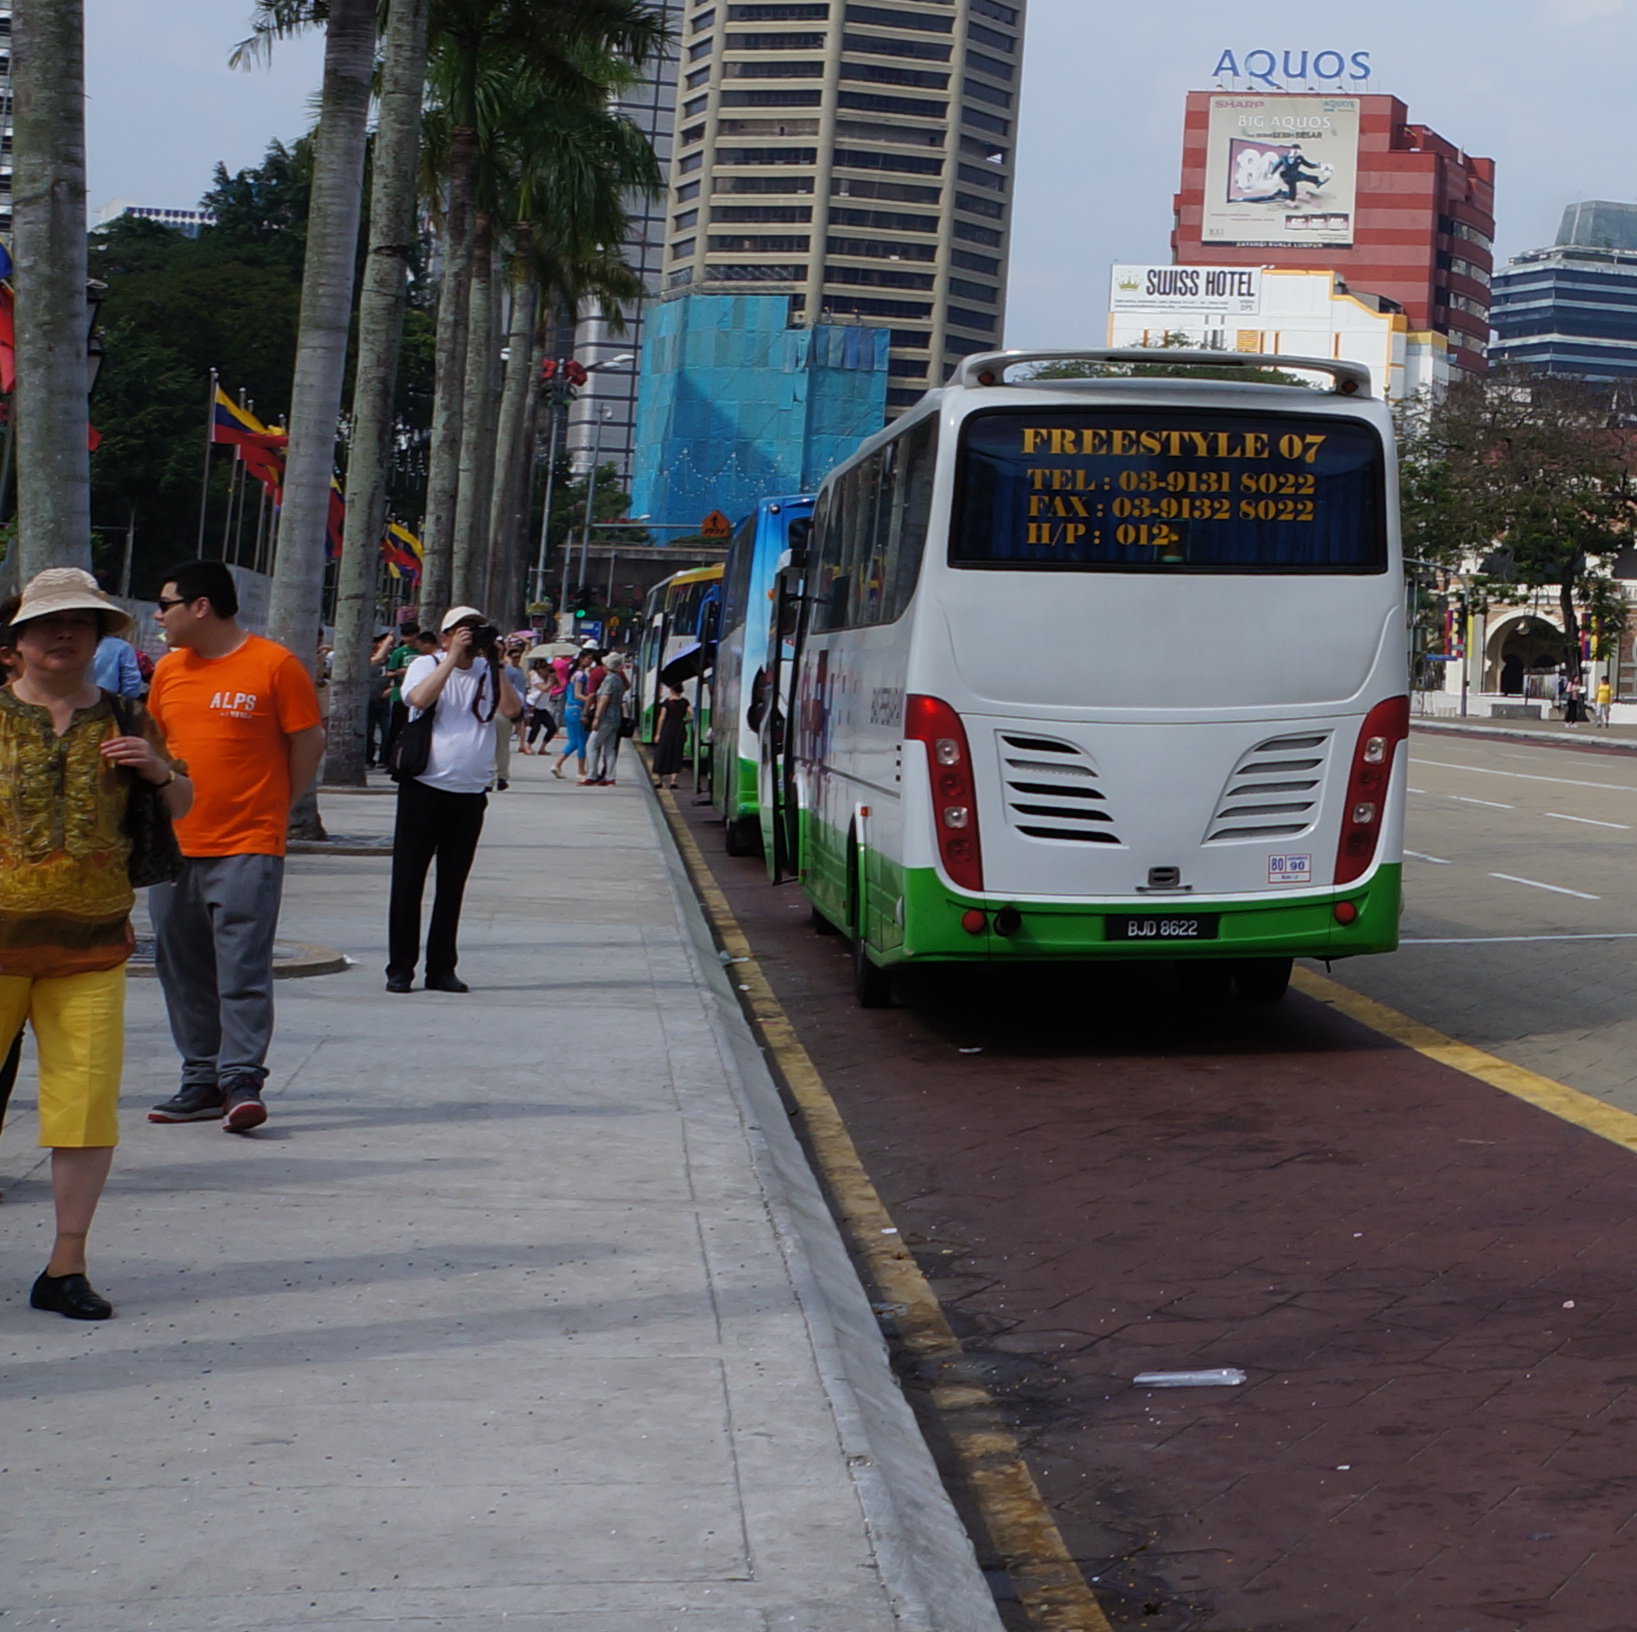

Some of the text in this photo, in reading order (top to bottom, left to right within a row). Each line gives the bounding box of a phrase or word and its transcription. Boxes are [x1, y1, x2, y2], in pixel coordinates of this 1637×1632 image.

[1212, 49, 1371, 86] AQUOS
[1215, 100, 1264, 109] SHARP
[1238, 115, 1331, 130] BIG AQUOS
[1146, 269, 1255, 297] SWISS HOTEL
[1020, 428, 1327, 464] FREESTYLE 07
[1026, 468, 1096, 491] TEL
[1118, 470, 1231, 493] 03-9131
[1240, 473, 1316, 495] 8022
[1027, 495, 1090, 517] FAX
[1111, 497, 1231, 520] 03-9132
[1239, 499, 1315, 521] 8022
[1026, 522, 1086, 547] H/P
[1115, 523, 1179, 546] 012-
[209, 691, 257, 711] ALPS
[1271, 857, 1305, 871] 80 90
[1127, 920, 1198, 936] BJD 8622
